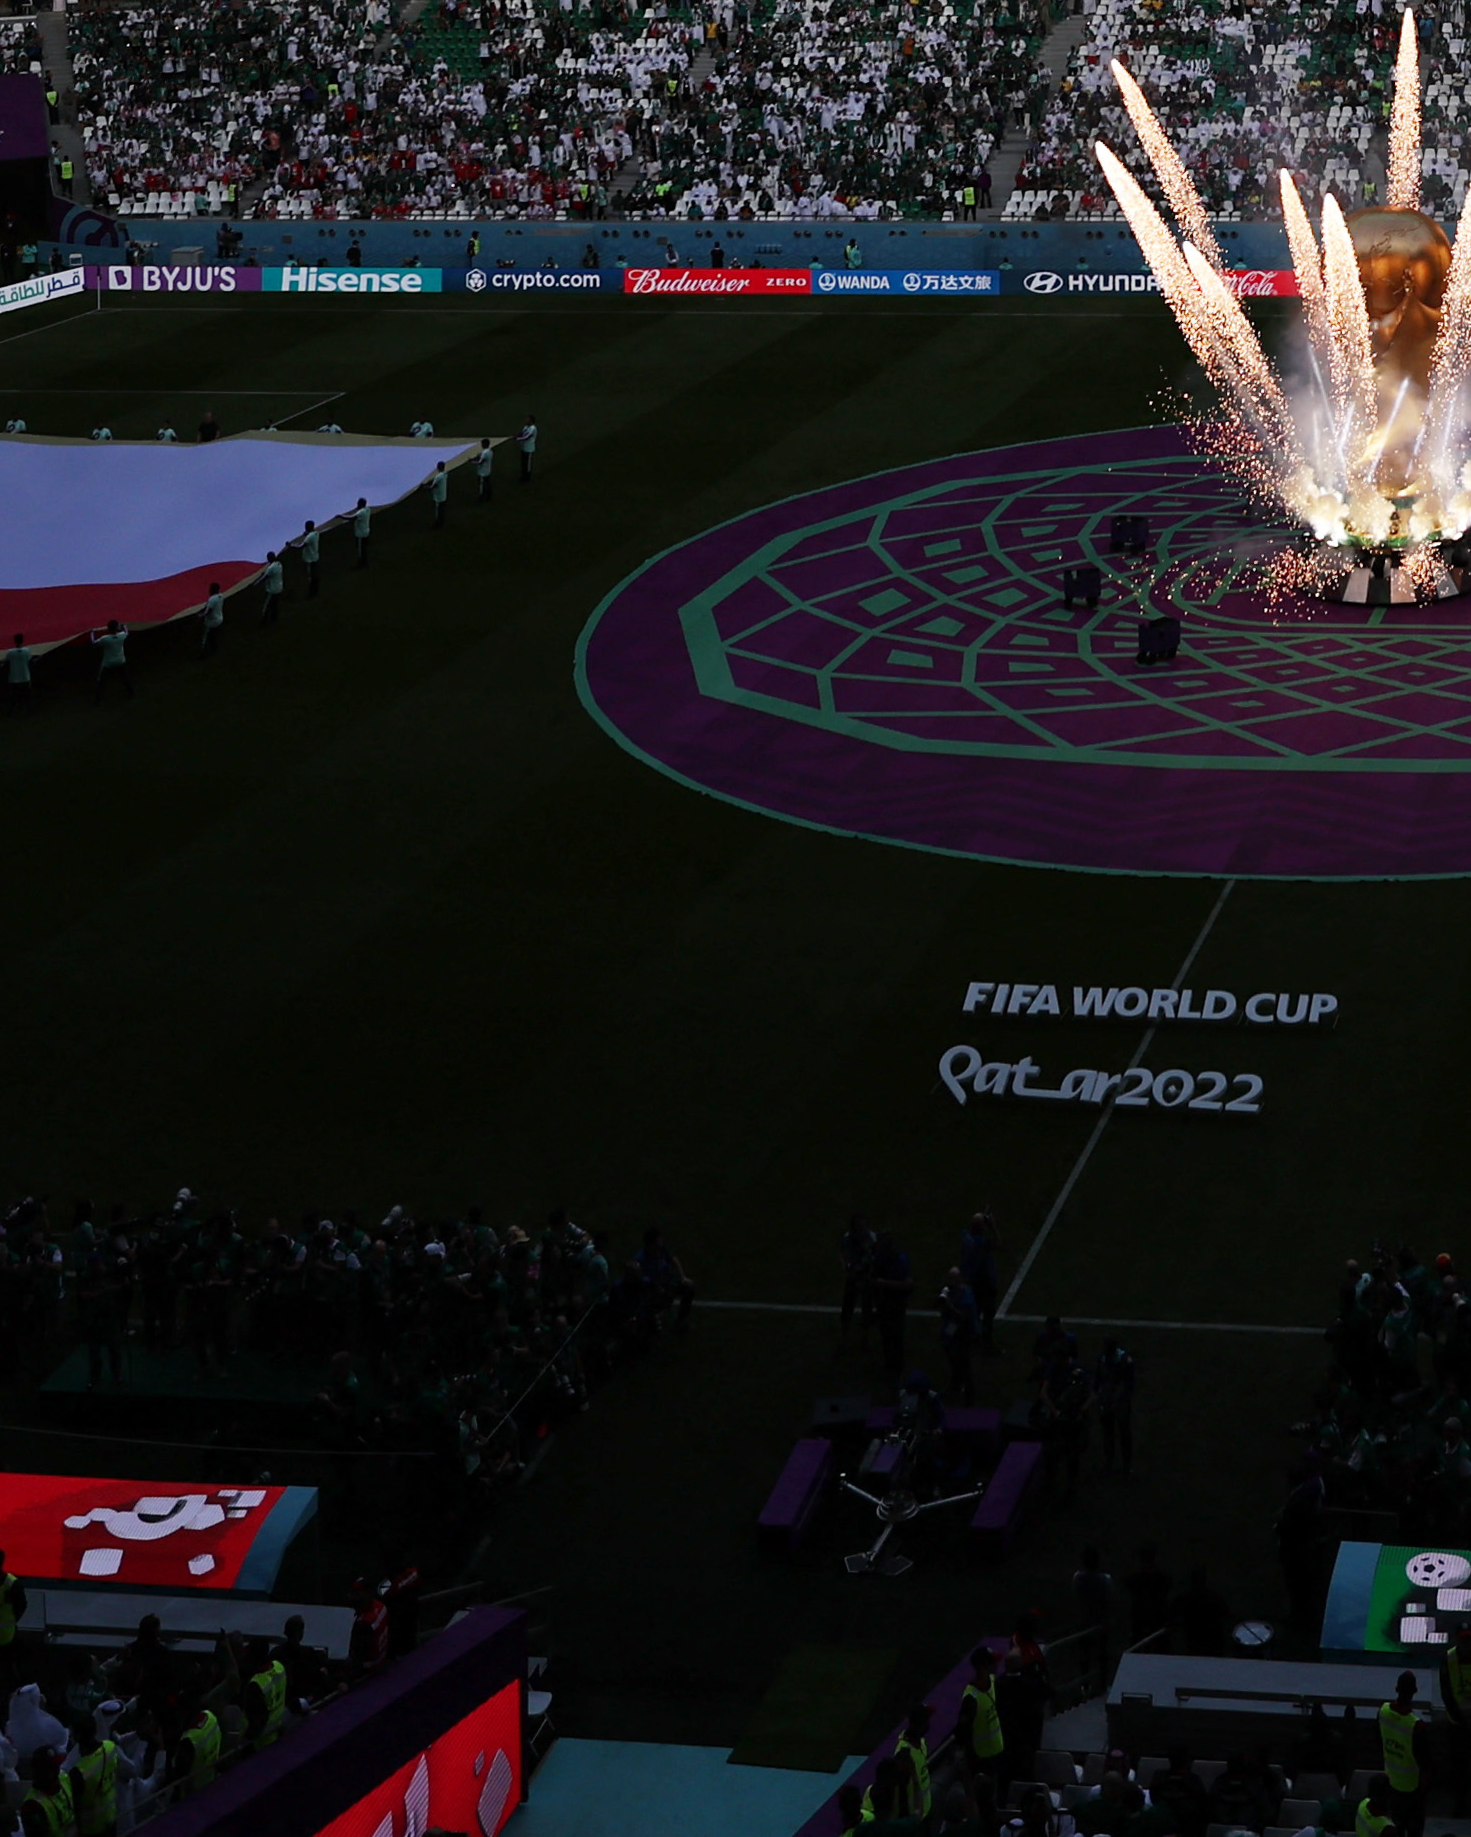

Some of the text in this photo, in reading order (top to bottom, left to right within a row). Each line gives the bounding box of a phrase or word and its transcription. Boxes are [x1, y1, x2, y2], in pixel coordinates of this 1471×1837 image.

[142, 266, 237, 293] BYJU'S
[280, 266, 423, 293] Hisense
[492, 272, 602, 292] crypto.com
[627, 269, 808, 294] Budweiser ZERO
[837, 275, 891, 290] WANDA
[922, 274, 993, 291] 万达文旅
[1067, 274, 1162, 292] HYUNDA
[961, 981, 1339, 1026] FIFA WORLD CUP
